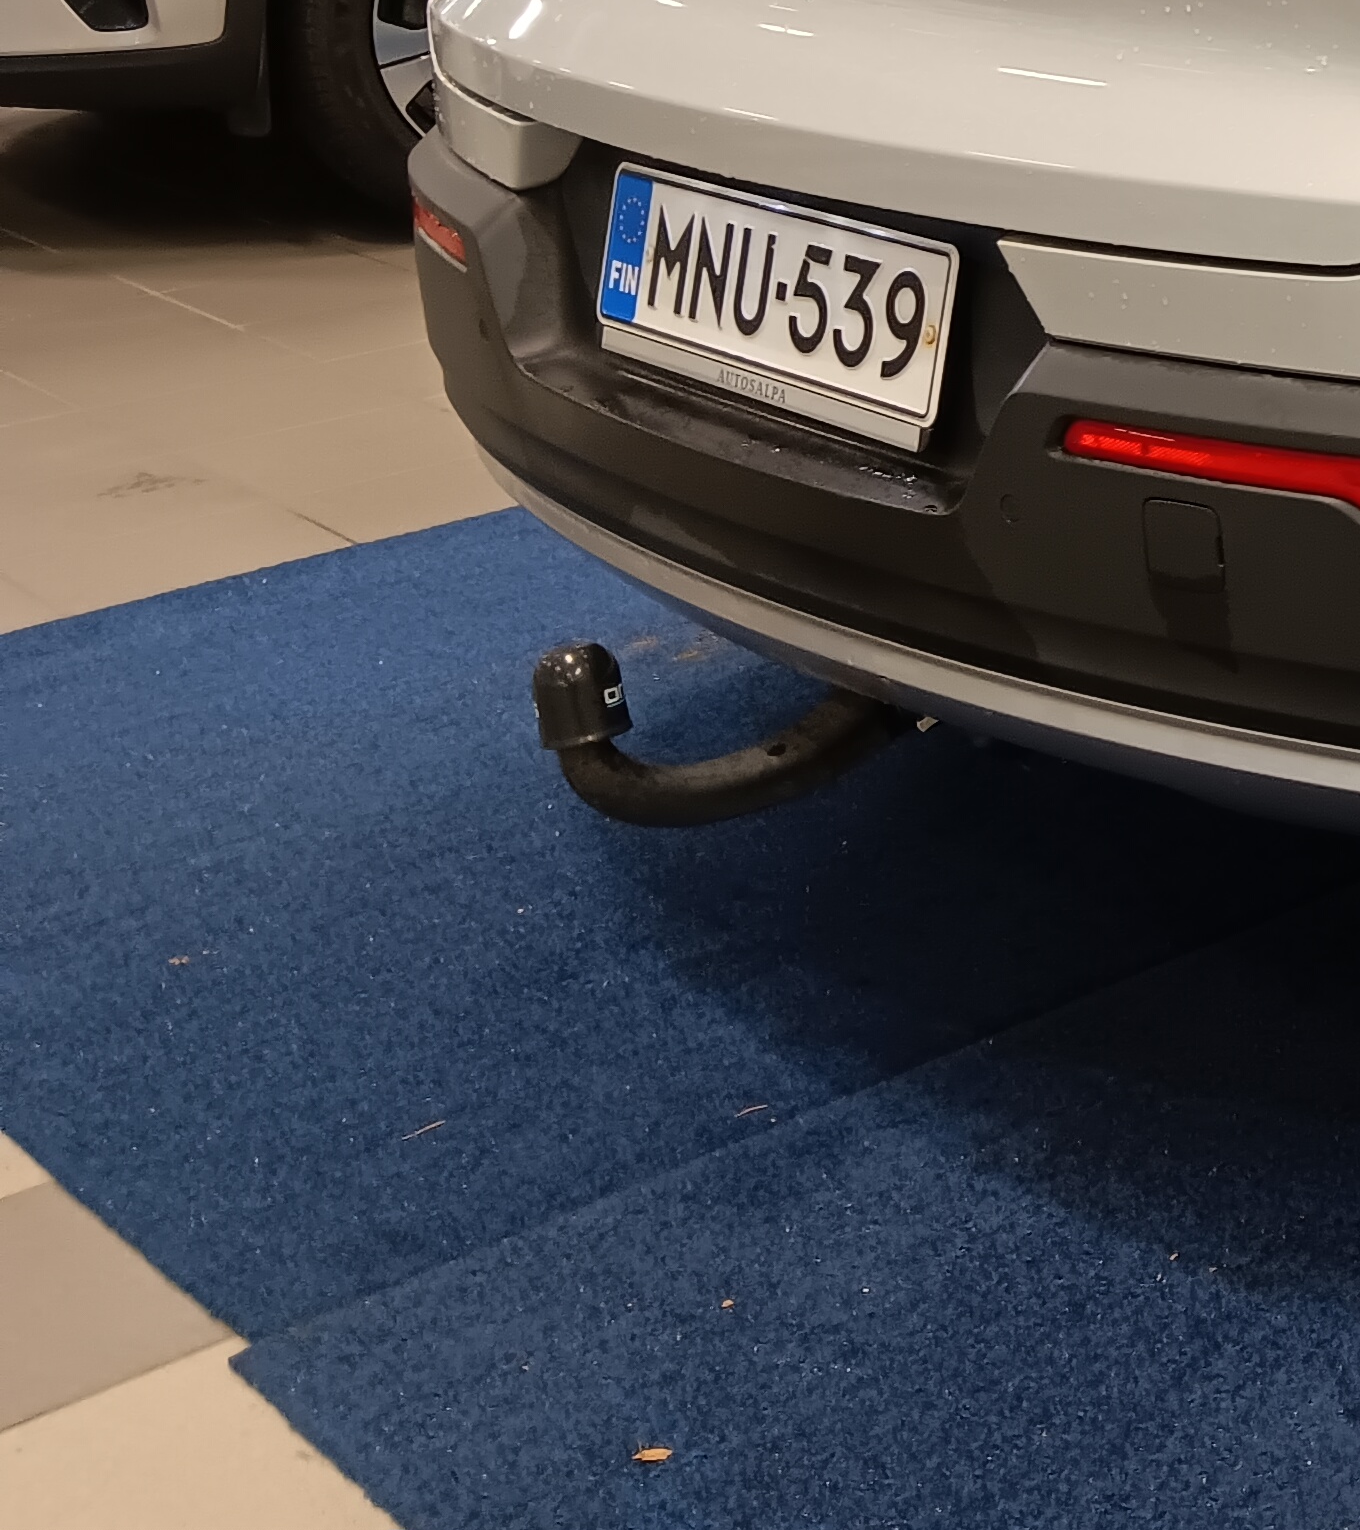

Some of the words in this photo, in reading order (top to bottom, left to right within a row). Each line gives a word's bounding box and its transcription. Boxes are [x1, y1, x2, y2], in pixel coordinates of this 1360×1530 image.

[608, 260, 639, 296] FIN
[647, 203, 926, 379] MNU-539
[715, 367, 787, 405] AUTOSALPA
